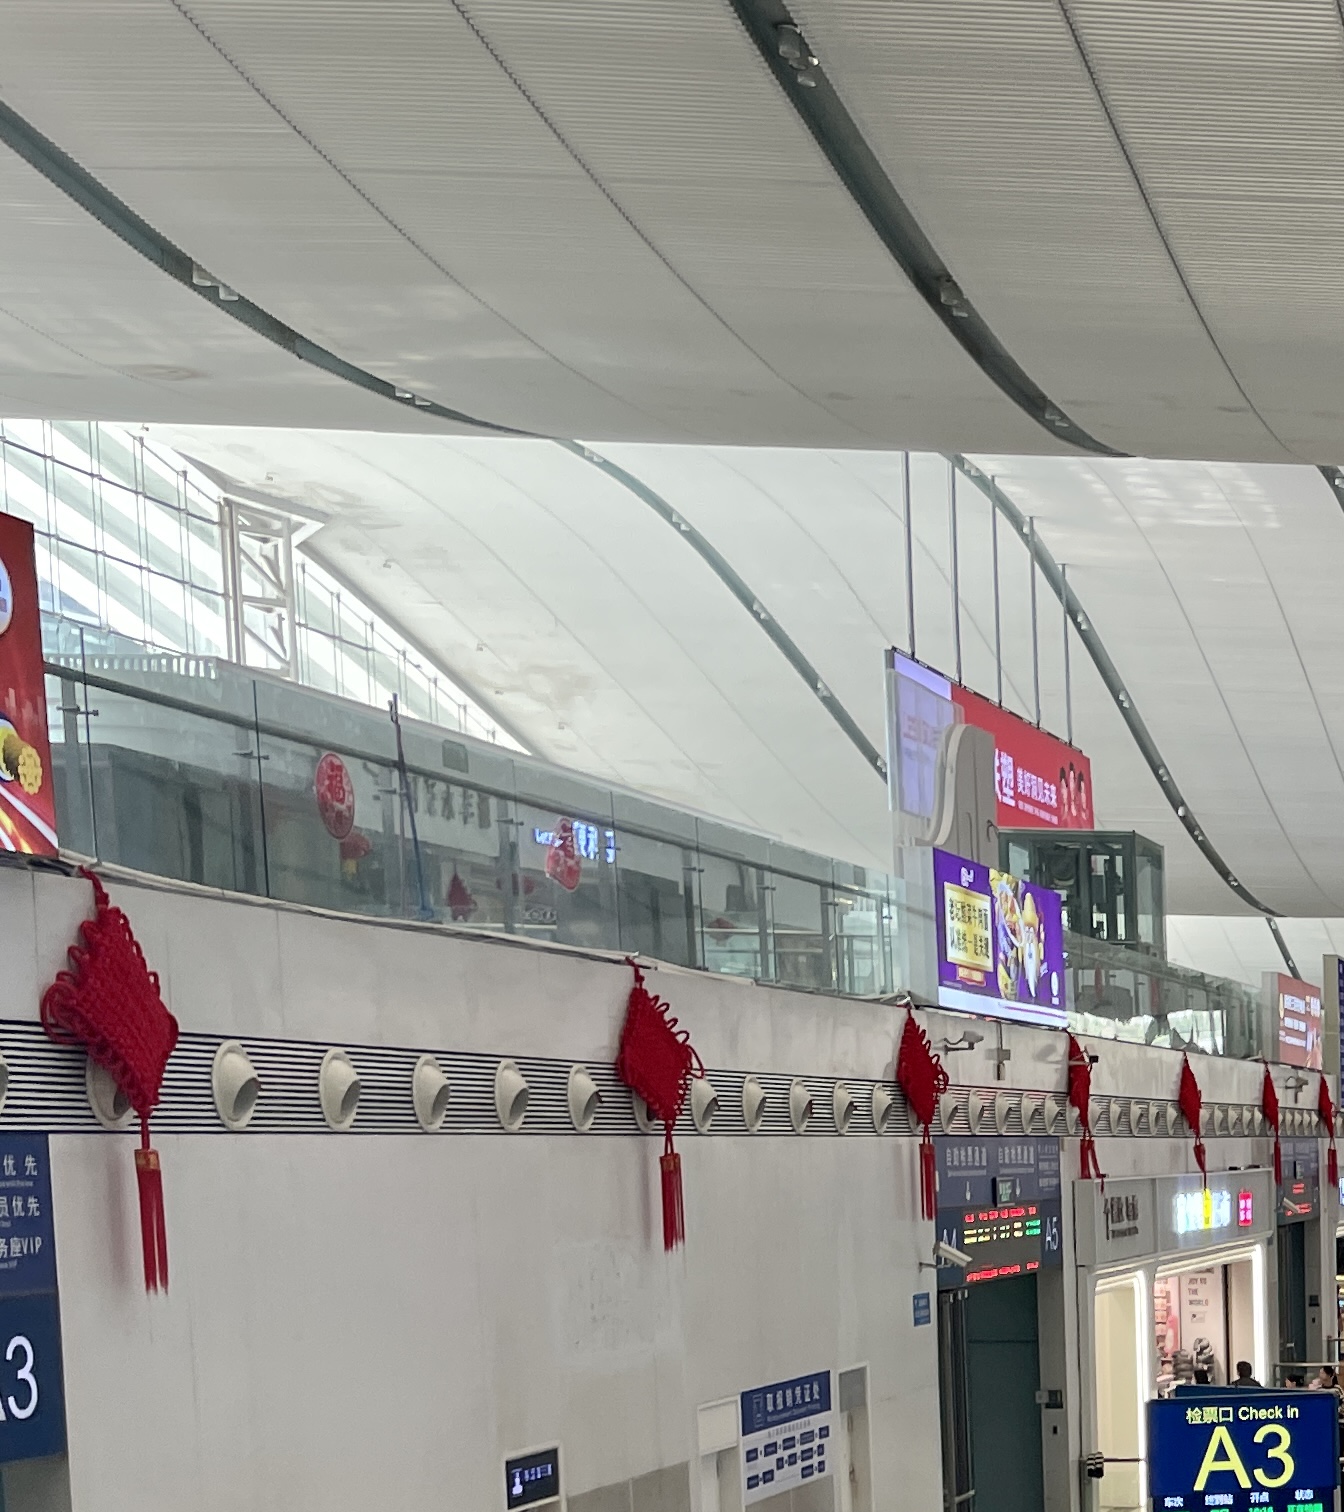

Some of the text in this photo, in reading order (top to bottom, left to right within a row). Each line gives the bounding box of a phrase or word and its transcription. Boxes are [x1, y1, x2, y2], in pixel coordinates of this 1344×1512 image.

[0, 1335, 39, 1422] 3
[1186, 1404, 1299, 1424] 检票口 Check in
[1193, 1423, 1295, 1491] A3
